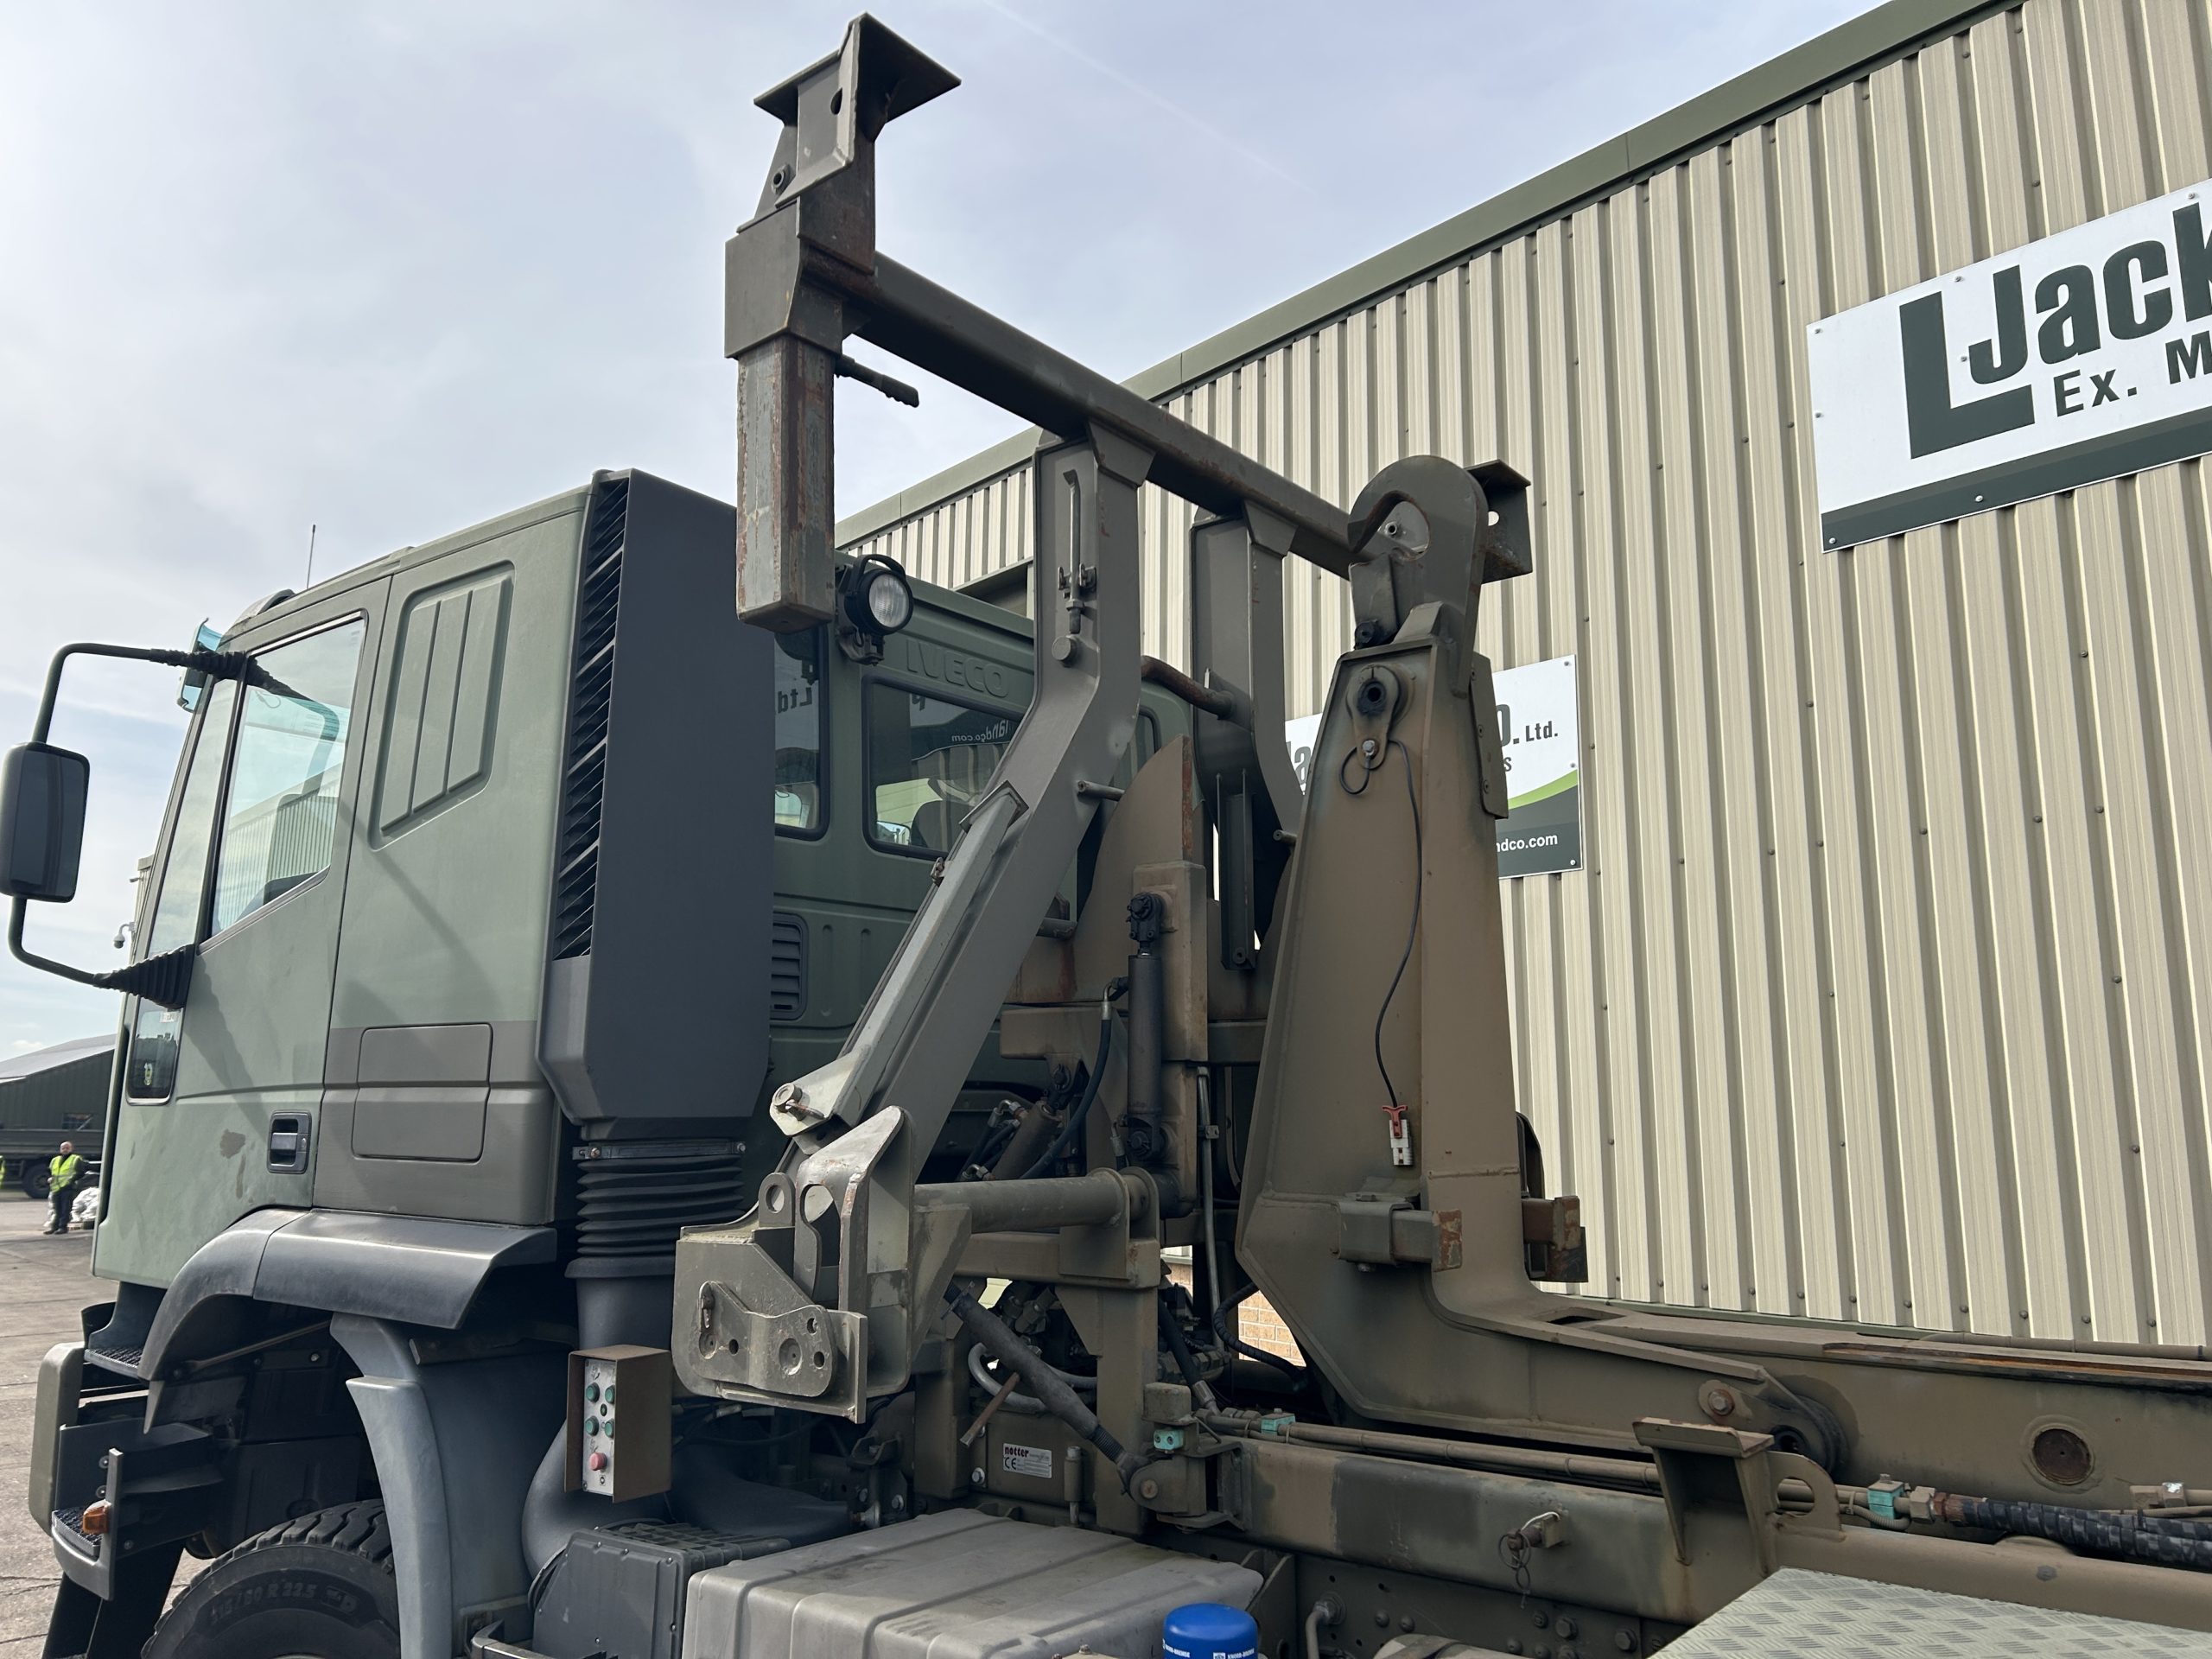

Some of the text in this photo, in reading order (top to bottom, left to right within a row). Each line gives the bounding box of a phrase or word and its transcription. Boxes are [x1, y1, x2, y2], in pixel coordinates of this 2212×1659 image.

[2053, 368, 2138, 417] Ex.
[906, 639, 1010, 698] IVECO
[1525, 720, 1559, 742] Ltd.
